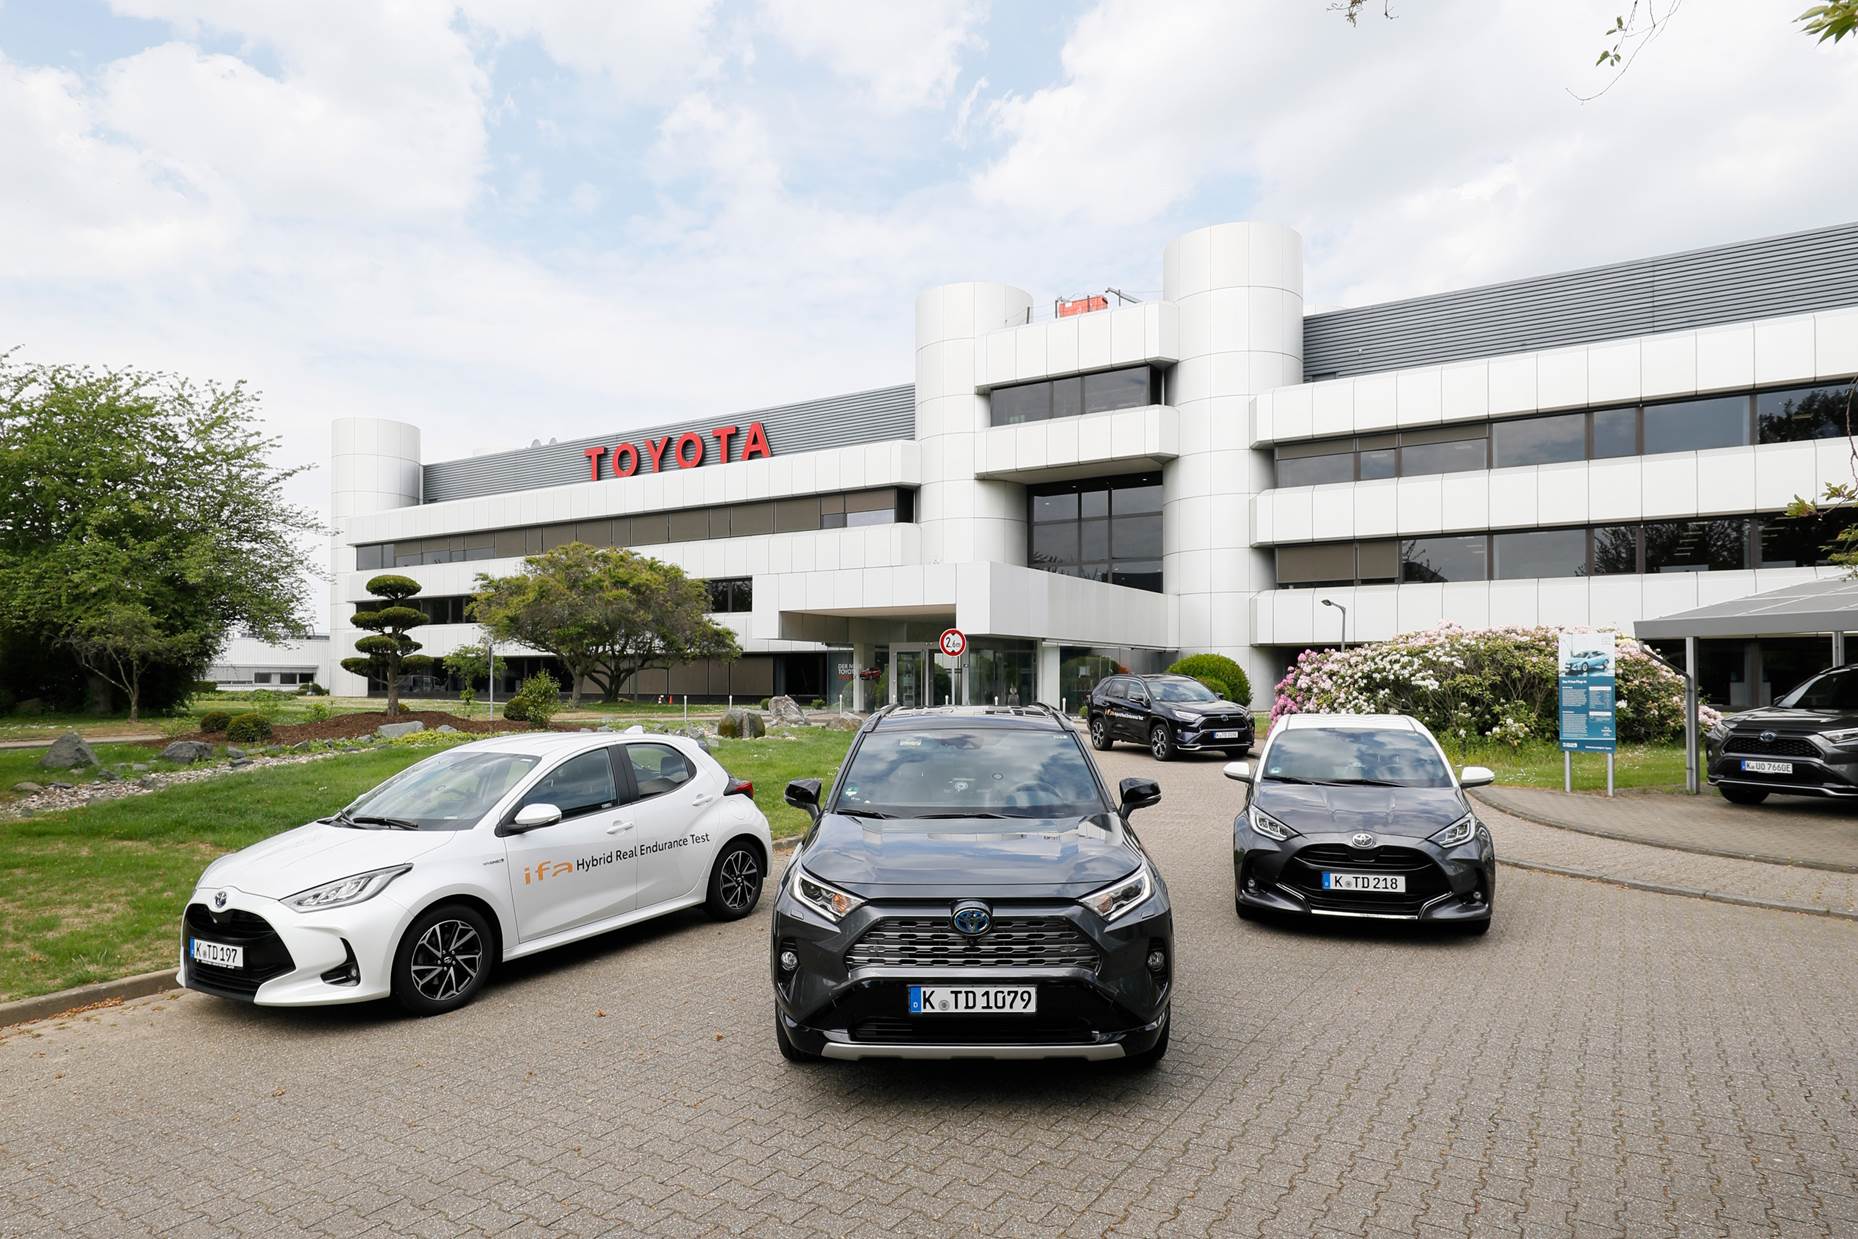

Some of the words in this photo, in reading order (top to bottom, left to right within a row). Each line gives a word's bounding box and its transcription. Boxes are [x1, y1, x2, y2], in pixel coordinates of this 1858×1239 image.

[584, 421, 773, 481] TOYOTA
[524, 860, 573, 885] ifa
[576, 849, 613, 872] Hybrid
[615, 846, 638, 861] Real
[640, 837, 688, 856] Endurance
[690, 832, 710, 844] Test
[1334, 875, 1343, 888] K
[196, 941, 202, 958] K
[922, 990, 935, 1010] K
